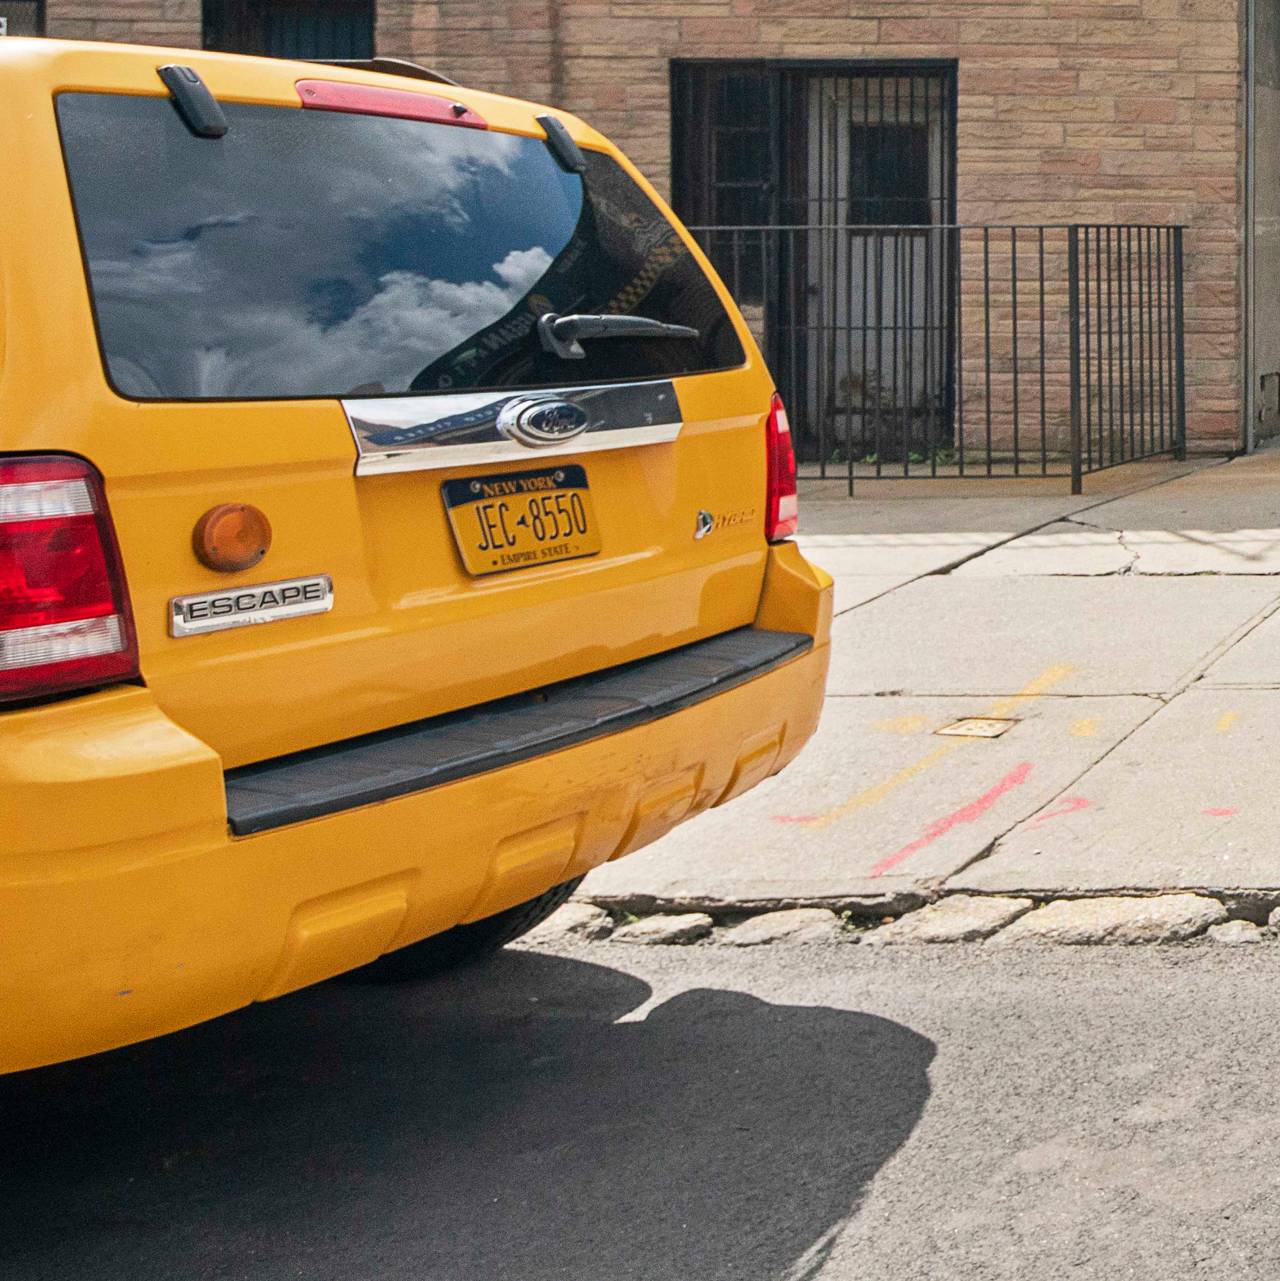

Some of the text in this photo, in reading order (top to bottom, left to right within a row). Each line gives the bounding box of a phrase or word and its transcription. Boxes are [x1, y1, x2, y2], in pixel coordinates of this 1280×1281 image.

[482, 475, 557, 497] NEW YORK
[475, 492, 588, 551] JEC 8550
[501, 543, 572, 566] EMPIRE STATE
[188, 582, 322, 619] ESCAPE
